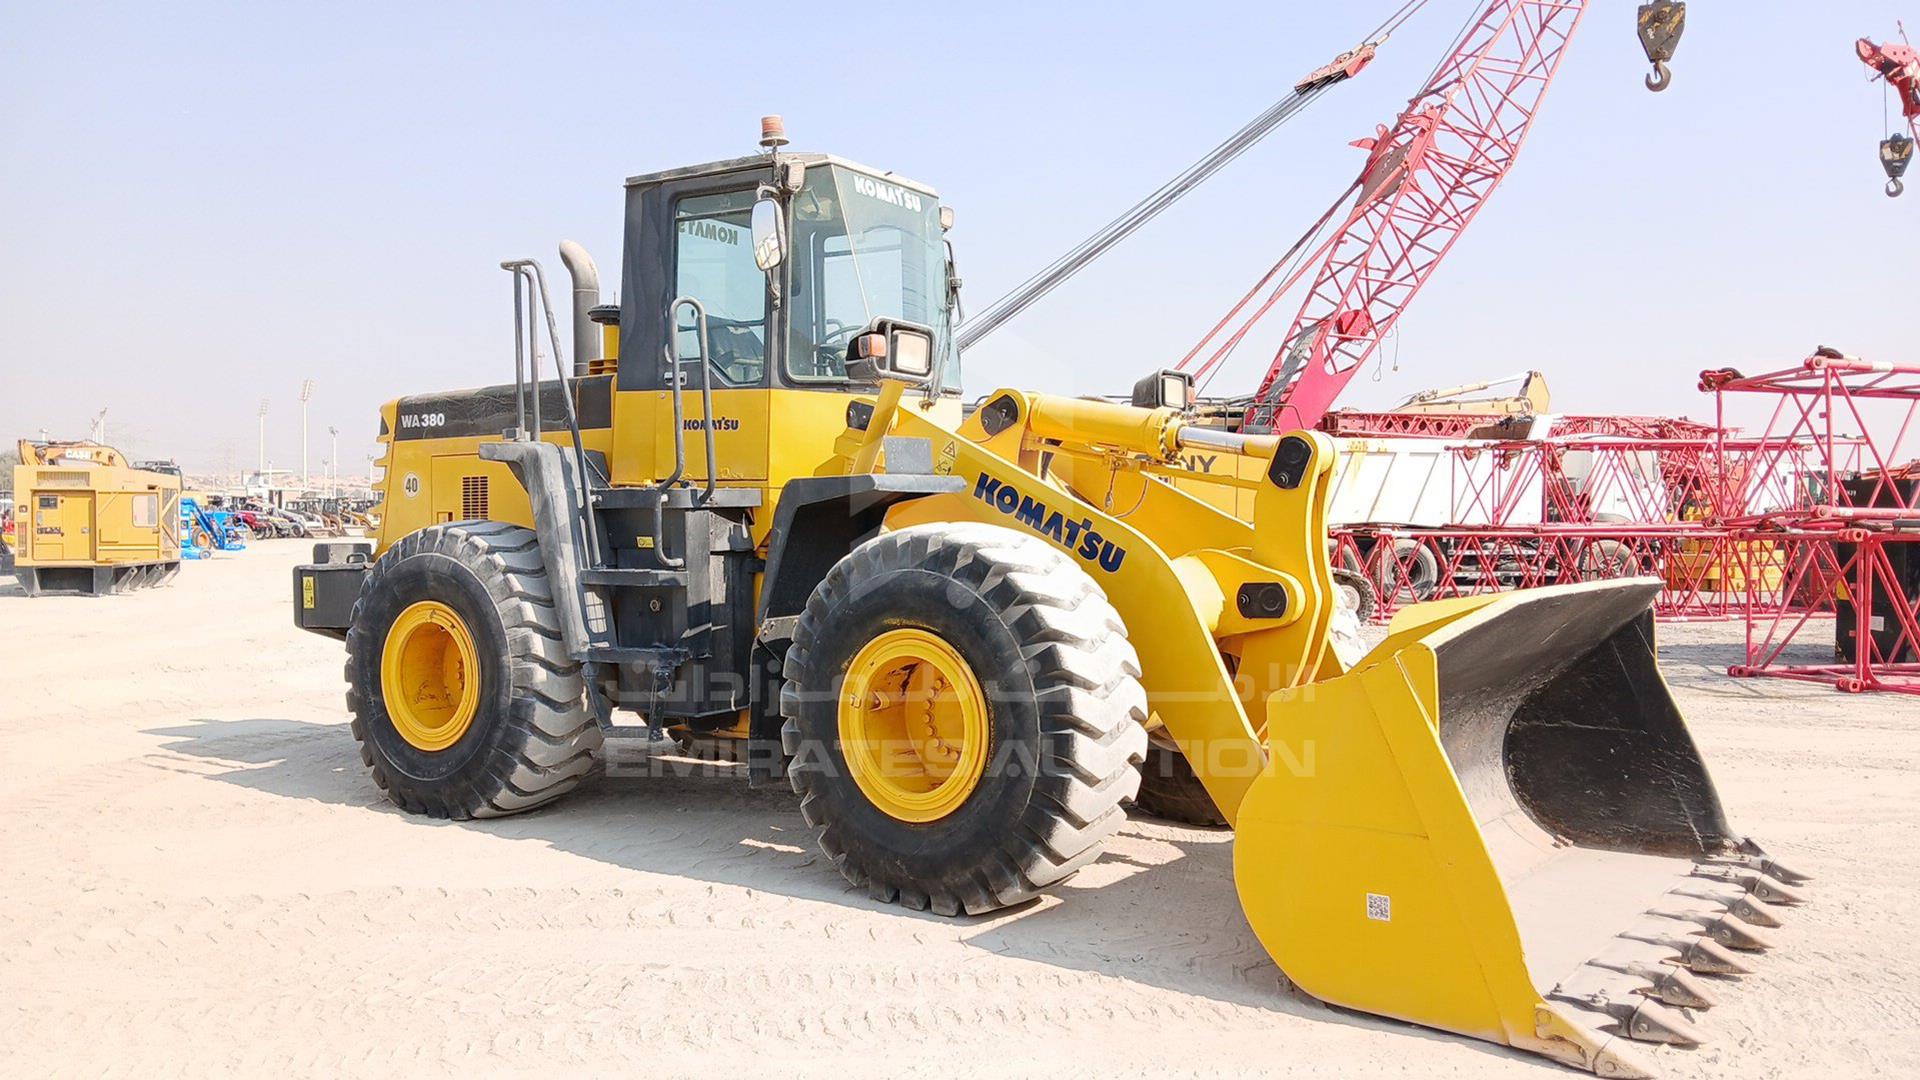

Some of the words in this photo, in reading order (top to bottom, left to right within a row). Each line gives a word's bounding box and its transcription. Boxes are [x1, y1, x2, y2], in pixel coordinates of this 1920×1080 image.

[853, 175, 921, 212] KOMATSU
[405, 478, 418, 492] 40
[973, 472, 1126, 572] KOMATSU
